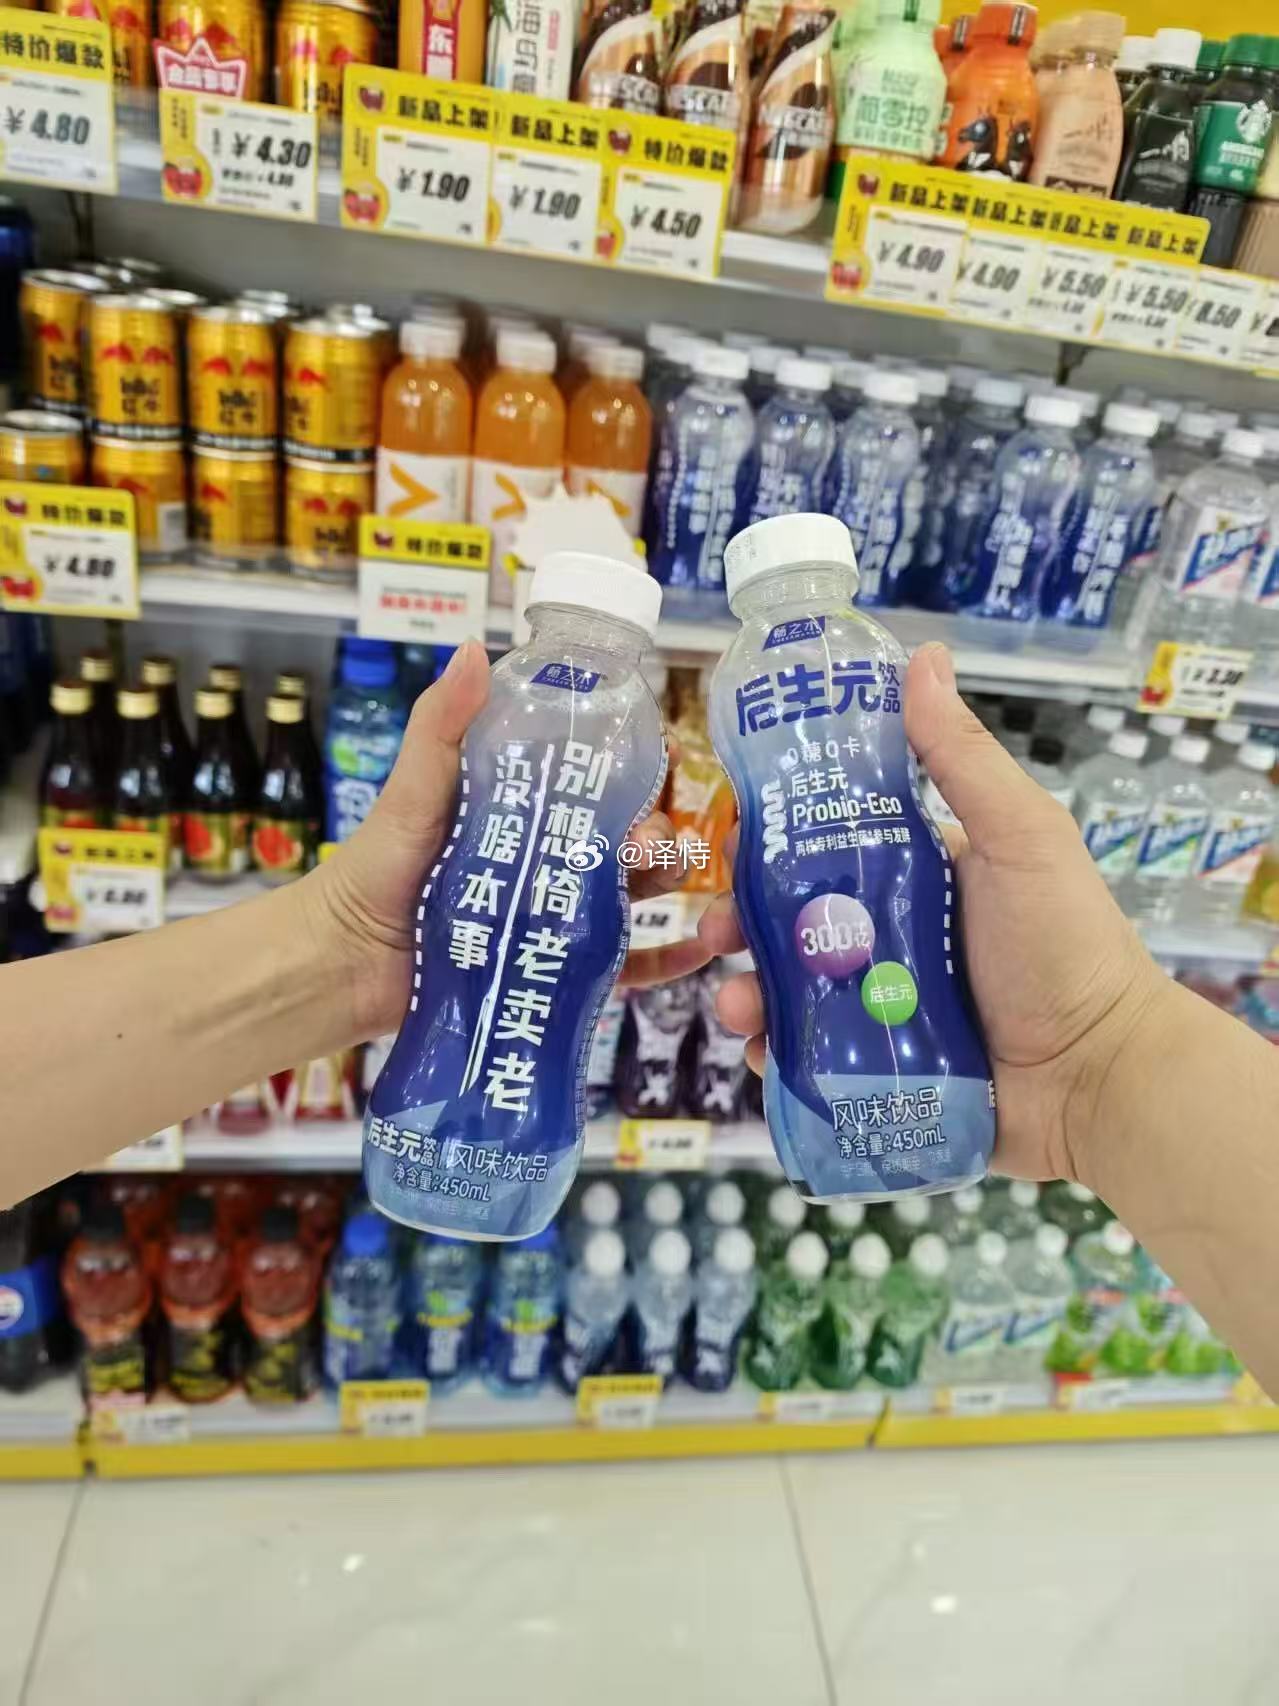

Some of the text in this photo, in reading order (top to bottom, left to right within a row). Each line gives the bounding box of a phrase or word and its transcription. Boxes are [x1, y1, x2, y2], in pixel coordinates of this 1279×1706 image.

[3, 32, 105, 70] 特价爆款
[4, 106, 91, 146] ¥4.80
[398, 96, 489, 131] 新品上架
[232, 131, 312, 169] ¥4.30
[511, 115, 599, 151] 新品上架
[643, 138, 727, 173] 特价爆款
[398, 168, 470, 203] ¥1.90
[510, 184, 582, 221] ¥1.90
[889, 181, 968, 214] 新品上架
[630, 204, 702, 239] ¥4.50
[878, 240, 946, 274] ¥4.90
[735, 660, 882, 737] 后生元
[878, 660, 902, 714] 饮品
[791, 766, 849, 798] 后生元
[792, 792, 903, 828] Probio-Eco
[447, 743, 534, 971] 没啥本事
[484, 739, 614, 1113] 别想倚老卖老
[870, 984, 914, 1005] 后生元
[831, 1088, 943, 1131] 风味饮品
[367, 1116, 422, 1163] 后生元
[419, 1136, 437, 1168] 饮品
[836, 1125, 946, 1159] 净含量:450mL
[445, 1143, 548, 1183] 风味饮品
